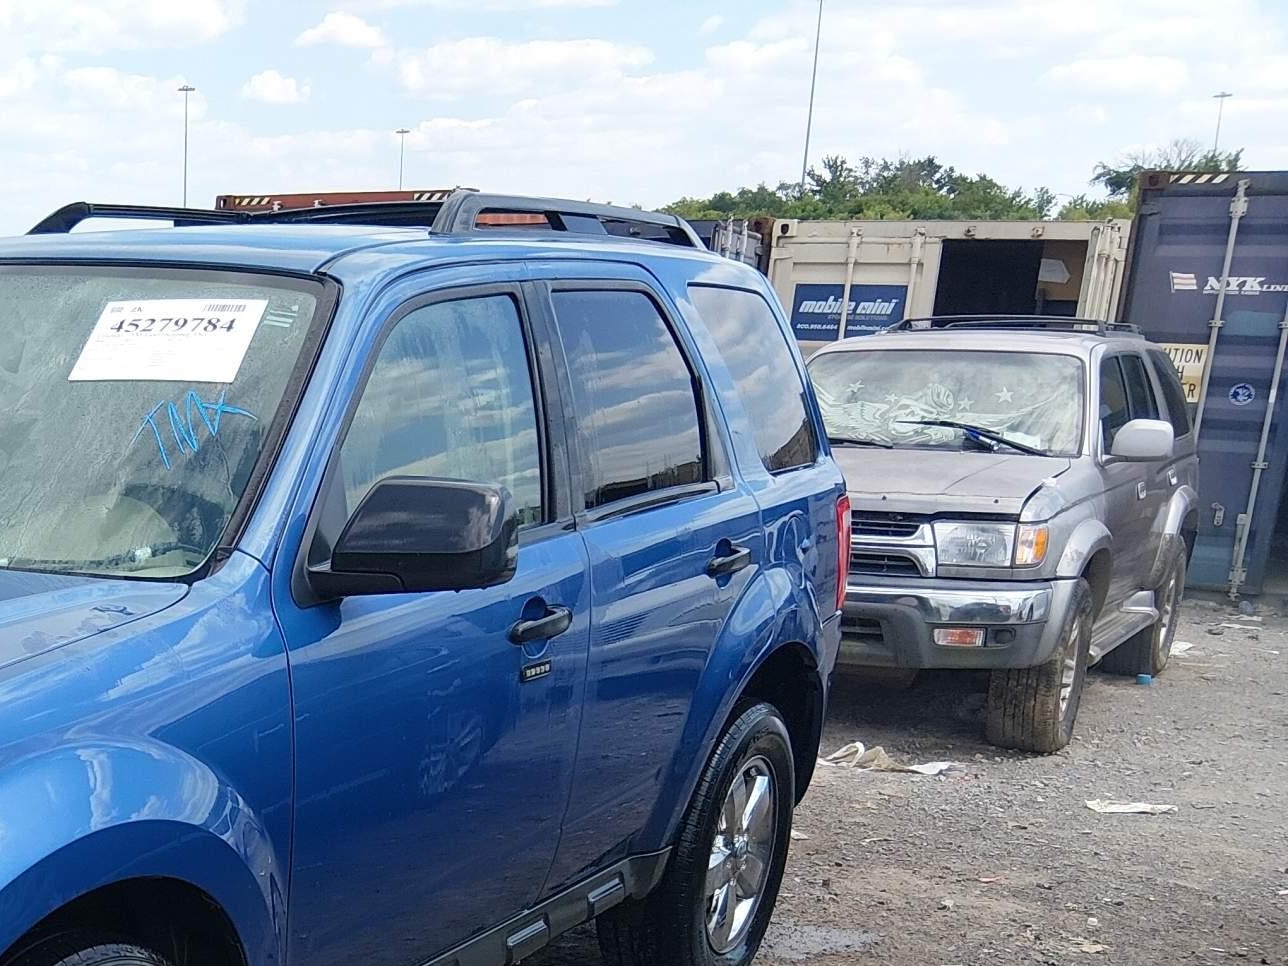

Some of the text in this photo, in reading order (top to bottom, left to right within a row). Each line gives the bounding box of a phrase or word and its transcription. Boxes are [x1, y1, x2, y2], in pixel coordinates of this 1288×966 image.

[1203, 276, 1266, 291] NYK
[855, 299, 897, 315] mini
[109, 317, 237, 334] 45279784
